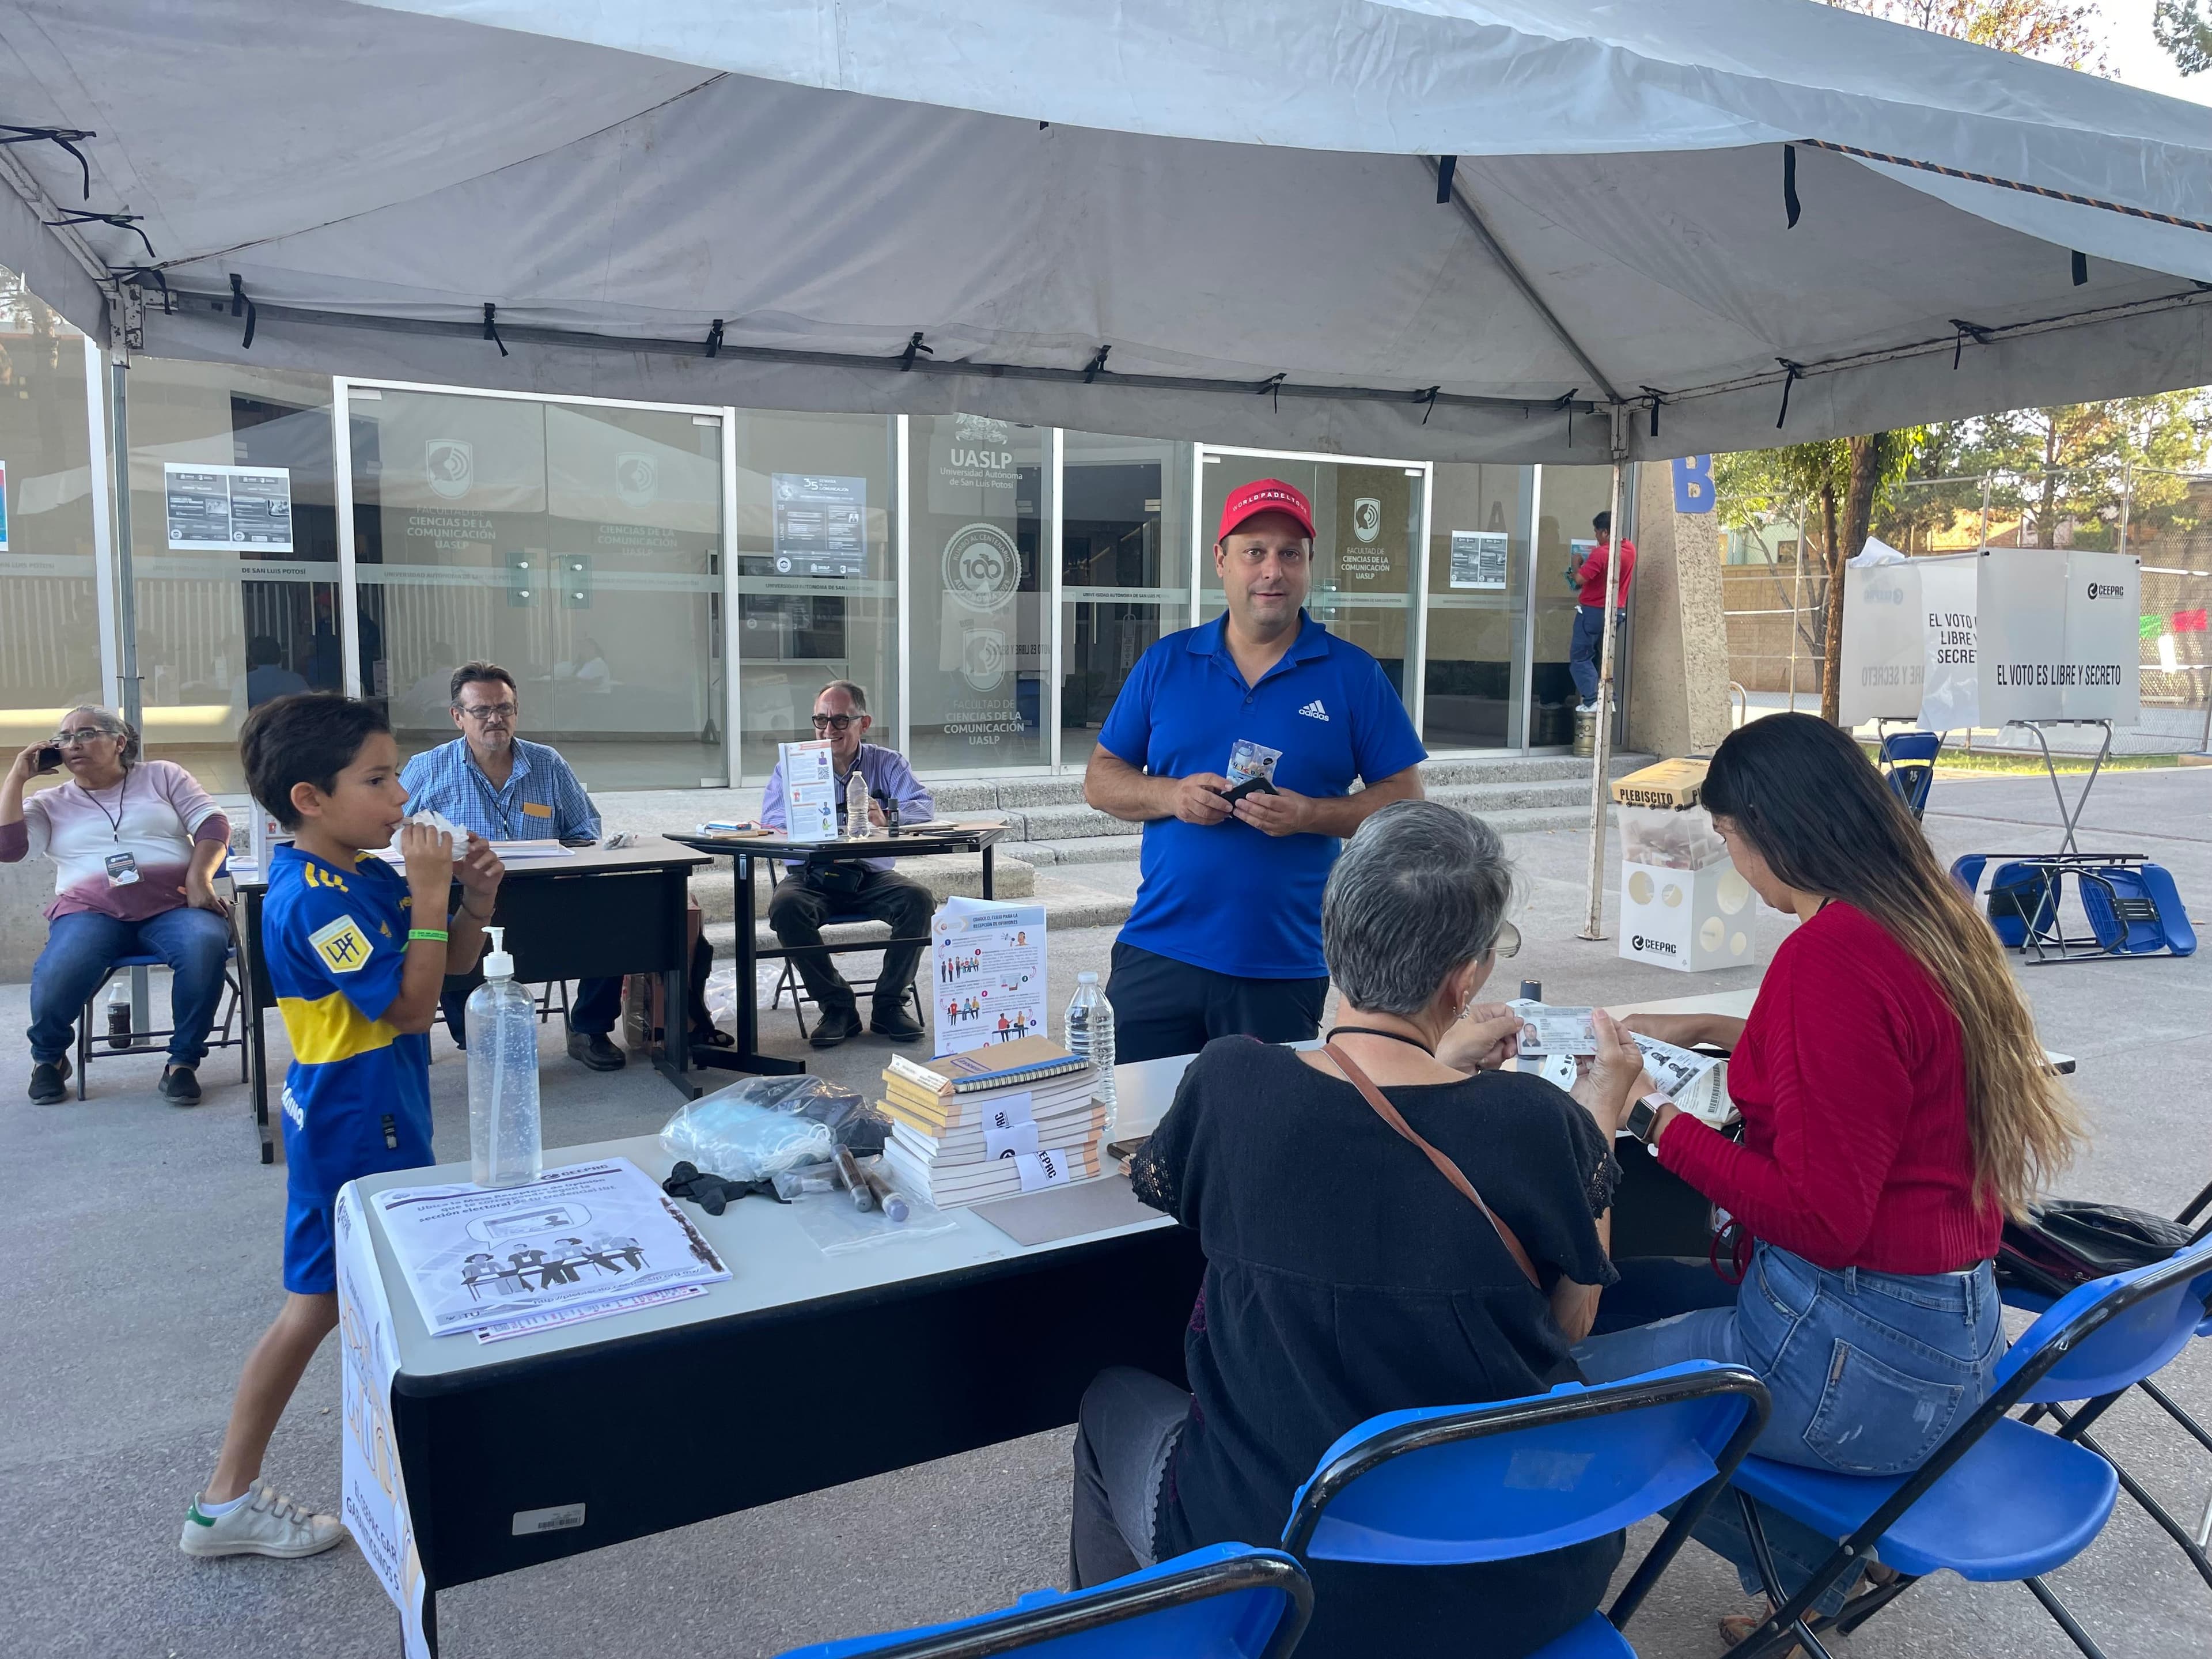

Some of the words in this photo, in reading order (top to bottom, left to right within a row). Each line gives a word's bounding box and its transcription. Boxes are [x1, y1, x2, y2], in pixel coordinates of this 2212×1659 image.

[951, 448, 1012, 469] UASLP
[940, 467, 983, 478] Universidad
[985, 470, 1022, 480] Autónoma
[804, 478, 819, 490] 35
[960, 478, 974, 486] San
[975, 479, 990, 488] Luis
[991, 480, 1014, 489] Potosí
[1673, 454, 1716, 513] B
[409, 517, 460, 527] CIENCIAS
[463, 519, 477, 528] DE
[479, 520, 493, 529] LA
[407, 528, 496, 540] COMUNICACIÓN
[599, 525, 645, 535] CIENCIAS
[647, 527, 661, 536] DE
[663, 528, 675, 537] LA
[435, 540, 469, 550] UASLP
[953, 538, 971, 562] RUMBO
[979, 534, 1010, 562] CENTENARIO
[622, 548, 653, 556] UASLP
[1341, 563, 1390, 572] COMUNICACIÓN
[2099, 585, 2124, 596] CEEPAC
[1929, 613, 1942, 627] EL
[1945, 613, 1972, 628] VOTO
[1941, 631, 1972, 645] LIBRE
[1997, 664, 2007, 685] EL
[2009, 664, 2033, 685] VOTO
[2037, 664, 2048, 685] ES
[2051, 665, 2075, 685] LIBRE
[2078, 665, 2084, 685] Y
[2085, 664, 2121, 685] SECRETO
[953, 700, 1001, 709] FACULTAD
[1003, 699, 1014, 709] DE
[945, 712, 992, 722] CIENCIAS
[994, 712, 1007, 720] DE
[1009, 711, 1022, 720] LA
[1298, 709, 1330, 722] adidas
[944, 721, 1025, 733] COMUNICACIÓN
[968, 735, 1000, 745] UASLP
[1620, 789, 1673, 805] PLEBISCITO
[1645, 939, 1676, 954] CEEPAC
[417, 1203, 449, 1211] Ubica
[494, 1188, 548, 1198] Receptora
[565, 1179, 606, 1187] Opinión
[479, 1192, 544, 1205] corresponde
[419, 1210, 460, 1222] sección
[462, 1199, 512, 1213] electoral
[543, 1188, 597, 1199] credencial
[346, 1497, 393, 1583] GARANTICEMOS
